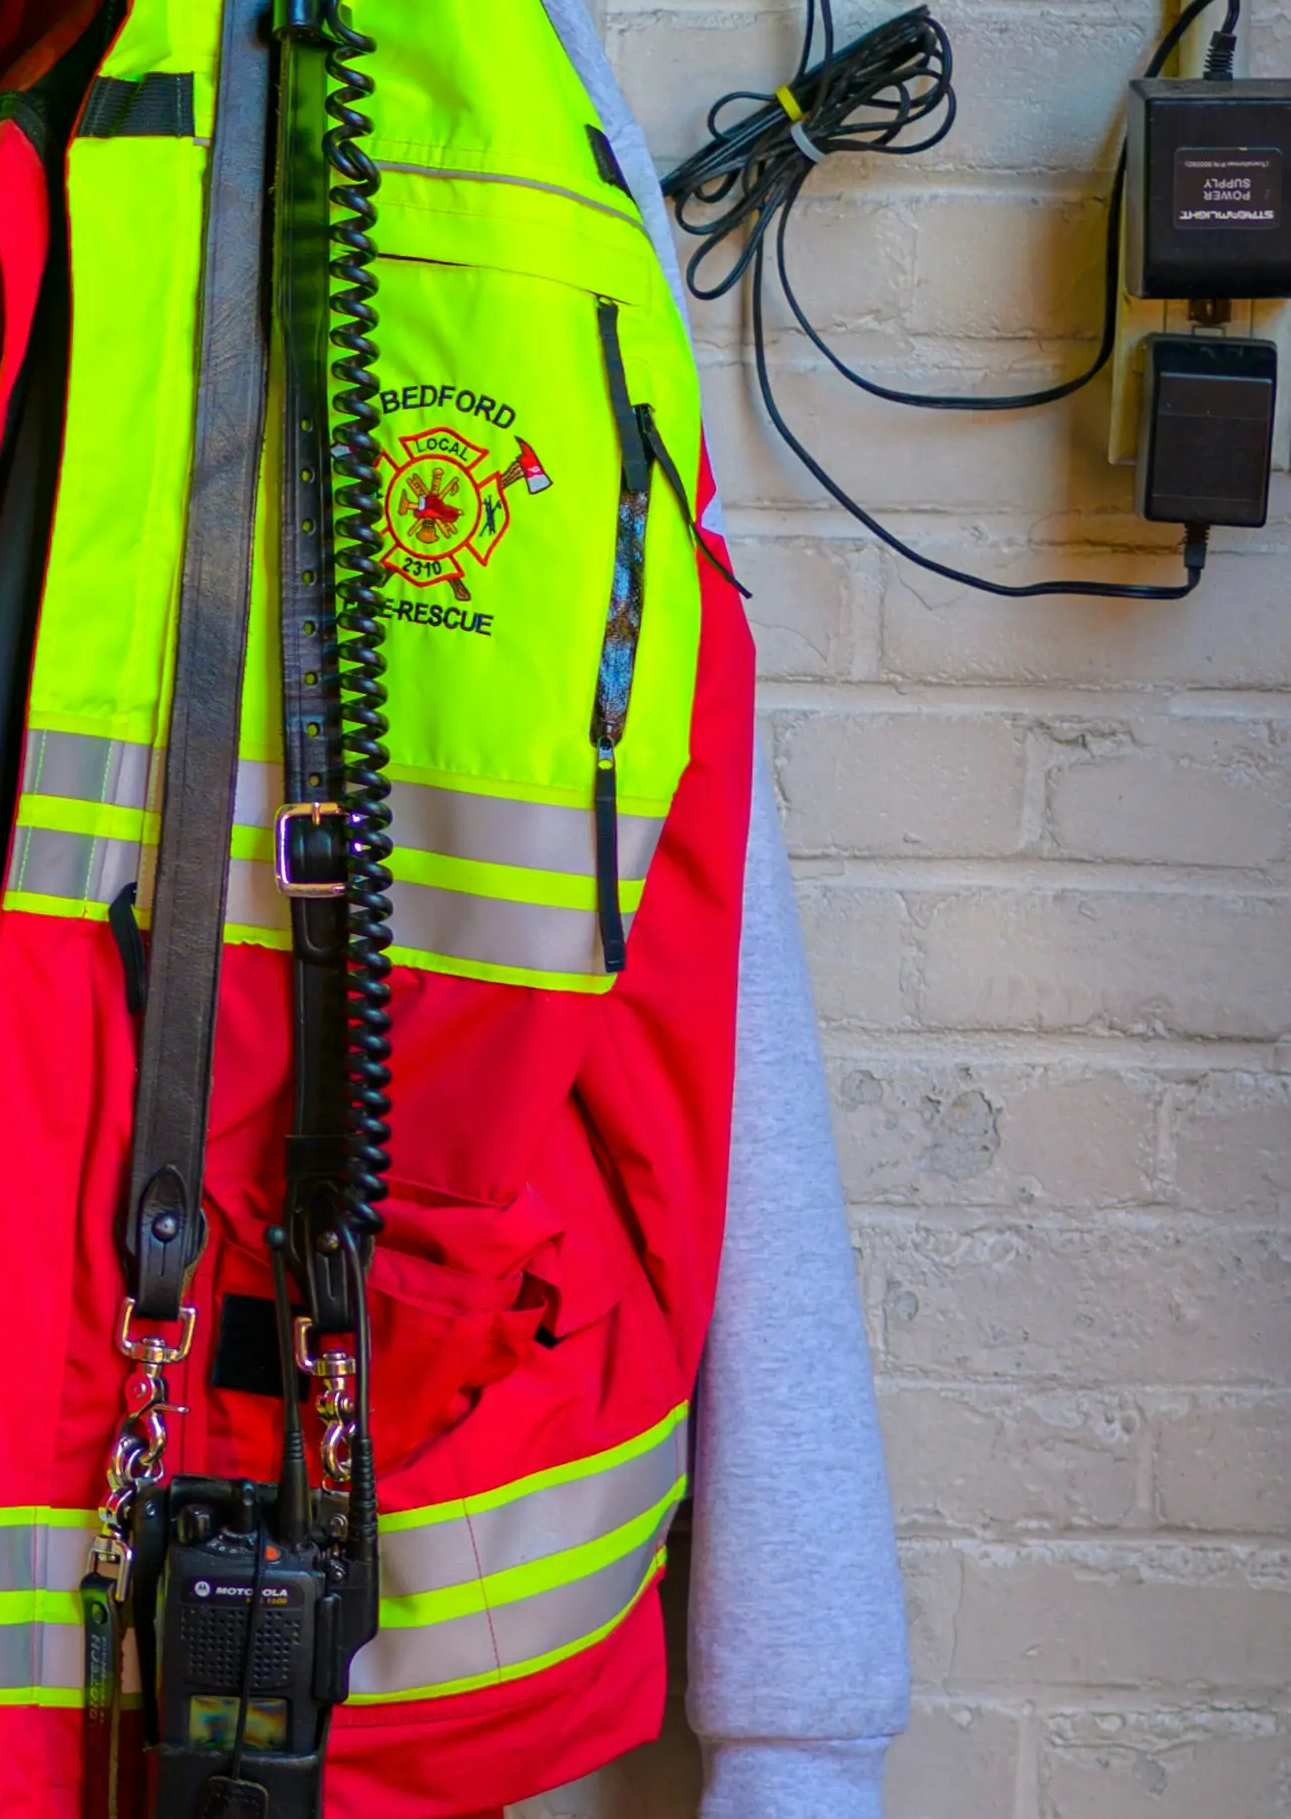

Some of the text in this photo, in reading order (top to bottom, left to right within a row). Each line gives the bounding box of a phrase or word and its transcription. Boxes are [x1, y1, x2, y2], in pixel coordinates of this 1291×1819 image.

[1203, 178, 1251, 189] SUPPLY
[1203, 190, 1251, 201] POWER
[379, 384, 516, 430] BEDFORD
[416, 438, 469, 461] LOCAL
[402, 557, 442, 577] 2310
[343, 598, 494, 637] E-RESCUE
[215, 1586, 288, 1597] MOTOOLA
